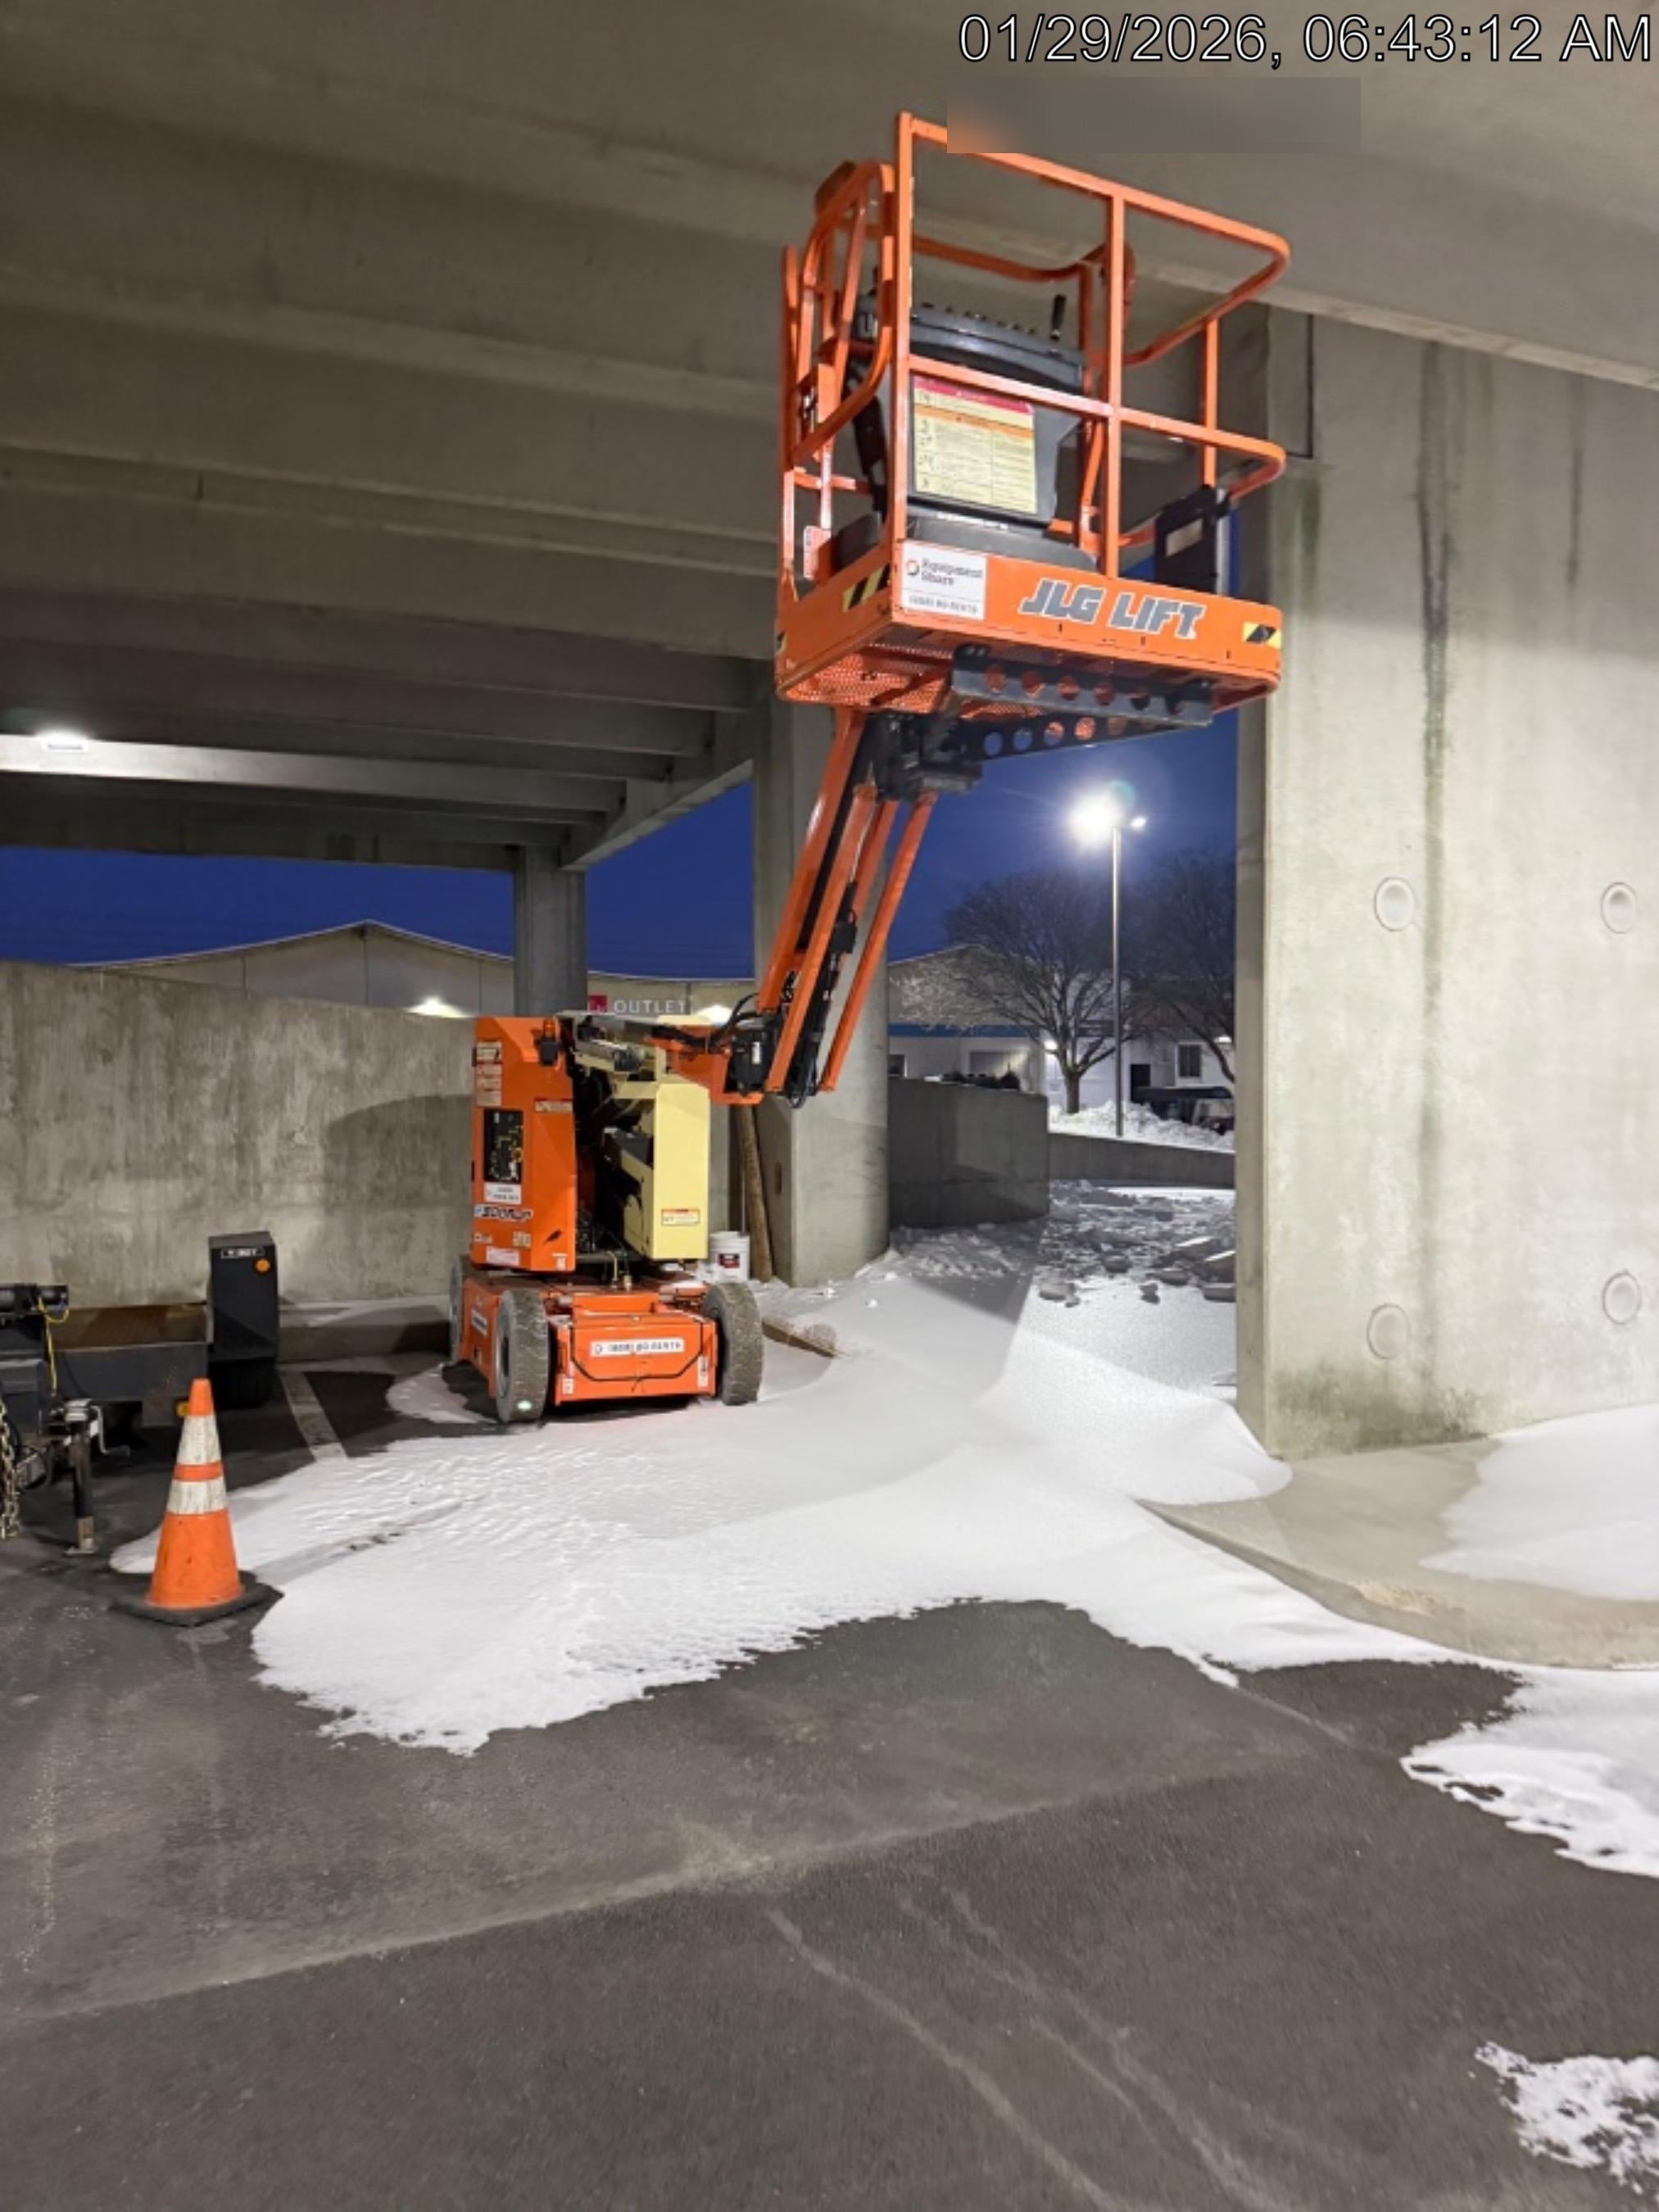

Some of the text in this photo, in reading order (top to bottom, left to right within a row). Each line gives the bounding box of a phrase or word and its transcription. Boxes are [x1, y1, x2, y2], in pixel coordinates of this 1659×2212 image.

[1018, 578, 1106, 623] JLG
[1108, 592, 1206, 639] LIFT
[614, 999, 686, 1013] OUTLET
